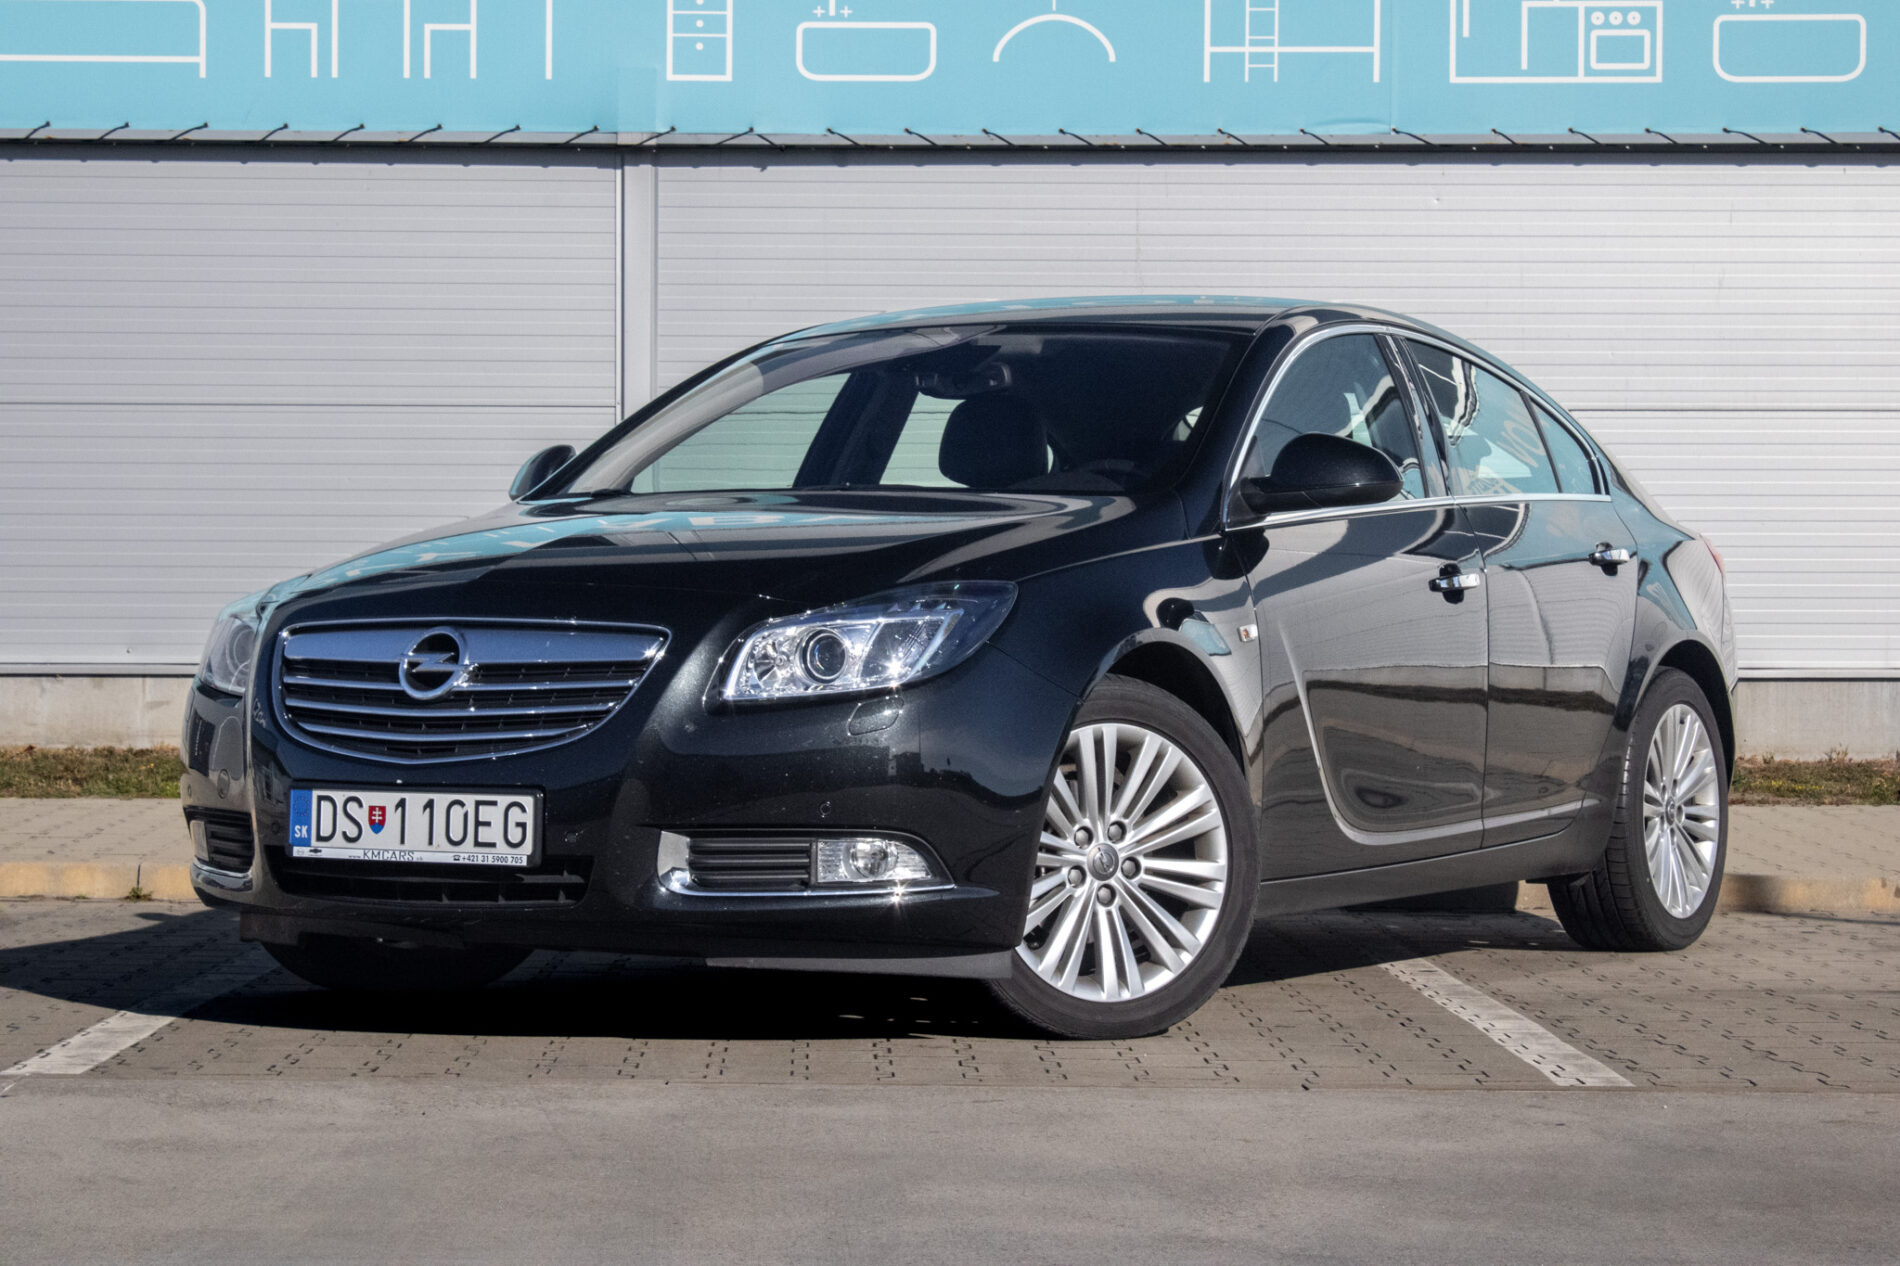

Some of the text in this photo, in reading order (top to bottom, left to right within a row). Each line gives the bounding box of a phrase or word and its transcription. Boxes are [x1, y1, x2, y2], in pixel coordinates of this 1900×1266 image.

[315, 794, 528, 849] DS 110EG
[294, 825, 308, 839] SK
[363, 849, 415, 861] KMCARS
[462, 854, 524, 864] +421 31 5900 705
